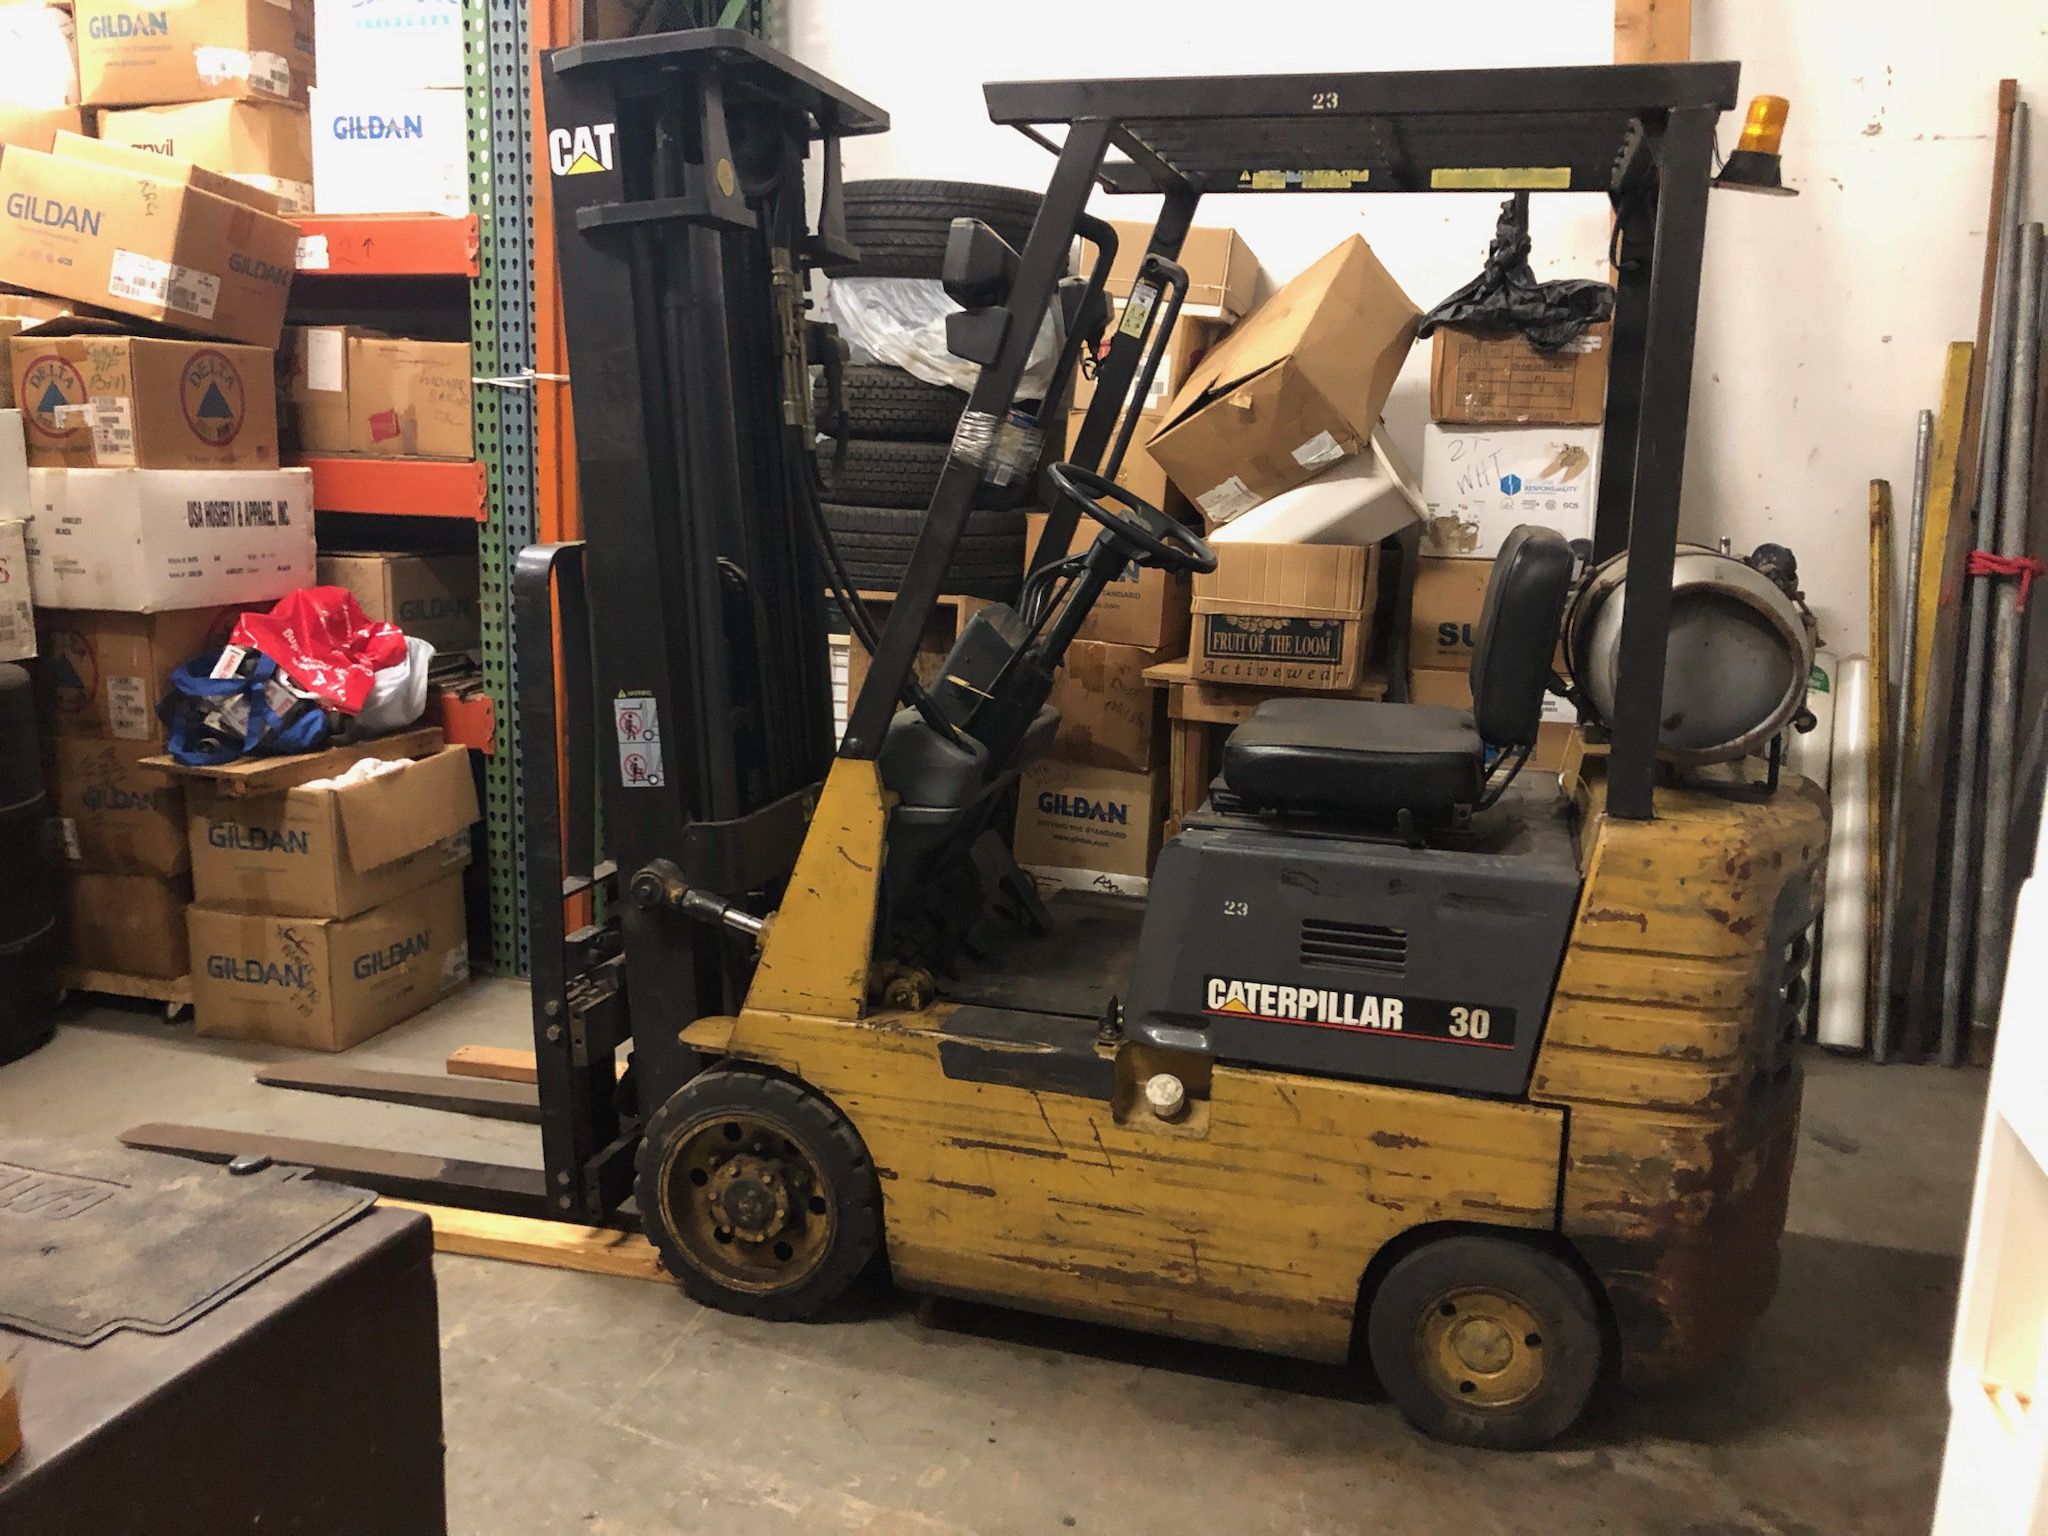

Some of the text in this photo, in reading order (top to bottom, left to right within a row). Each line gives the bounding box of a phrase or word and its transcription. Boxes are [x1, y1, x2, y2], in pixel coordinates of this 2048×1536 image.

[89, 11, 168, 39] GILDAN
[1312, 92, 1338, 110] 23
[333, 115, 423, 140] GILDAN
[549, 123, 616, 176] CAT
[6, 192, 102, 236] GILDAN
[228, 253, 290, 286] GILDAN
[31, 363, 75, 390] DELTA
[188, 358, 235, 389] DELTA
[187, 500, 204, 528] USA
[204, 500, 236, 528] HOSIERY
[236, 500, 243, 527] &
[1102, 590, 1142, 600] TANDARD
[1213, 630, 1331, 656] FRUIT OF THE LOOM
[1200, 660, 1344, 682] Activewear
[1037, 791, 1128, 826] GILDAN
[207, 822, 309, 855] GILDAN
[1069, 824, 1084, 833] THE
[1085, 826, 1127, 840] STANDARD
[1224, 901, 1249, 917] 23
[353, 932, 432, 980] GILDAN
[206, 955, 306, 988] GILDAN
[1206, 978, 1491, 1039] CATERPILLAR 30
